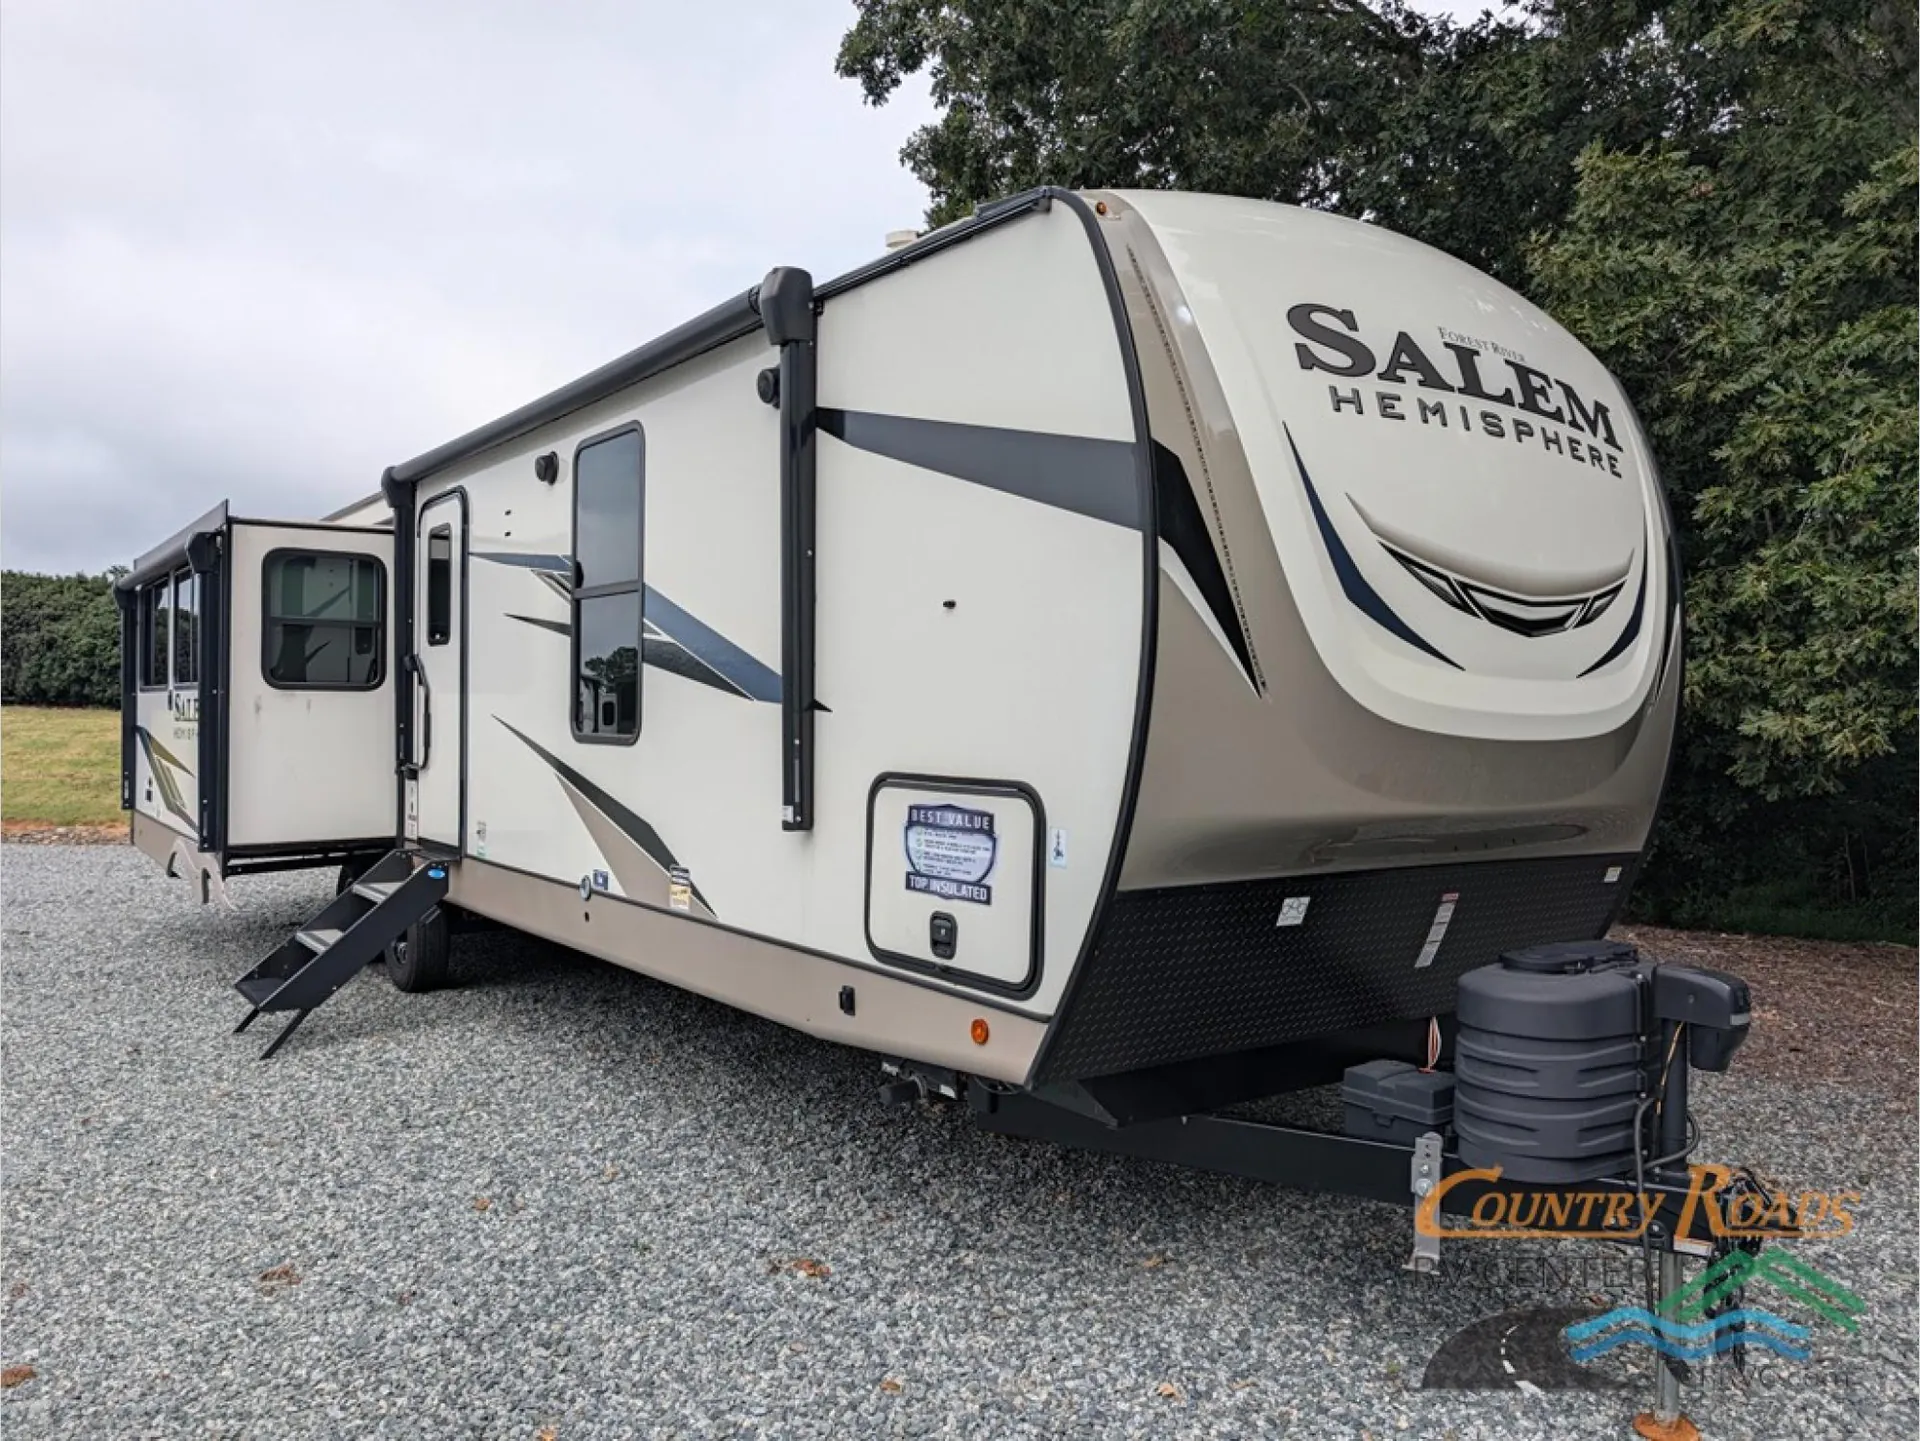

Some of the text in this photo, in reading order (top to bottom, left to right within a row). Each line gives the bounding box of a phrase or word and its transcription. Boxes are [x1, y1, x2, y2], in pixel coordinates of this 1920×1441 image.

[1286, 303, 1624, 452] SALEM
[1328, 385, 1623, 479] HEMISPHERE
[910, 808, 991, 831] BEST VALUE
[909, 875, 988, 901] TOP INSULATED
